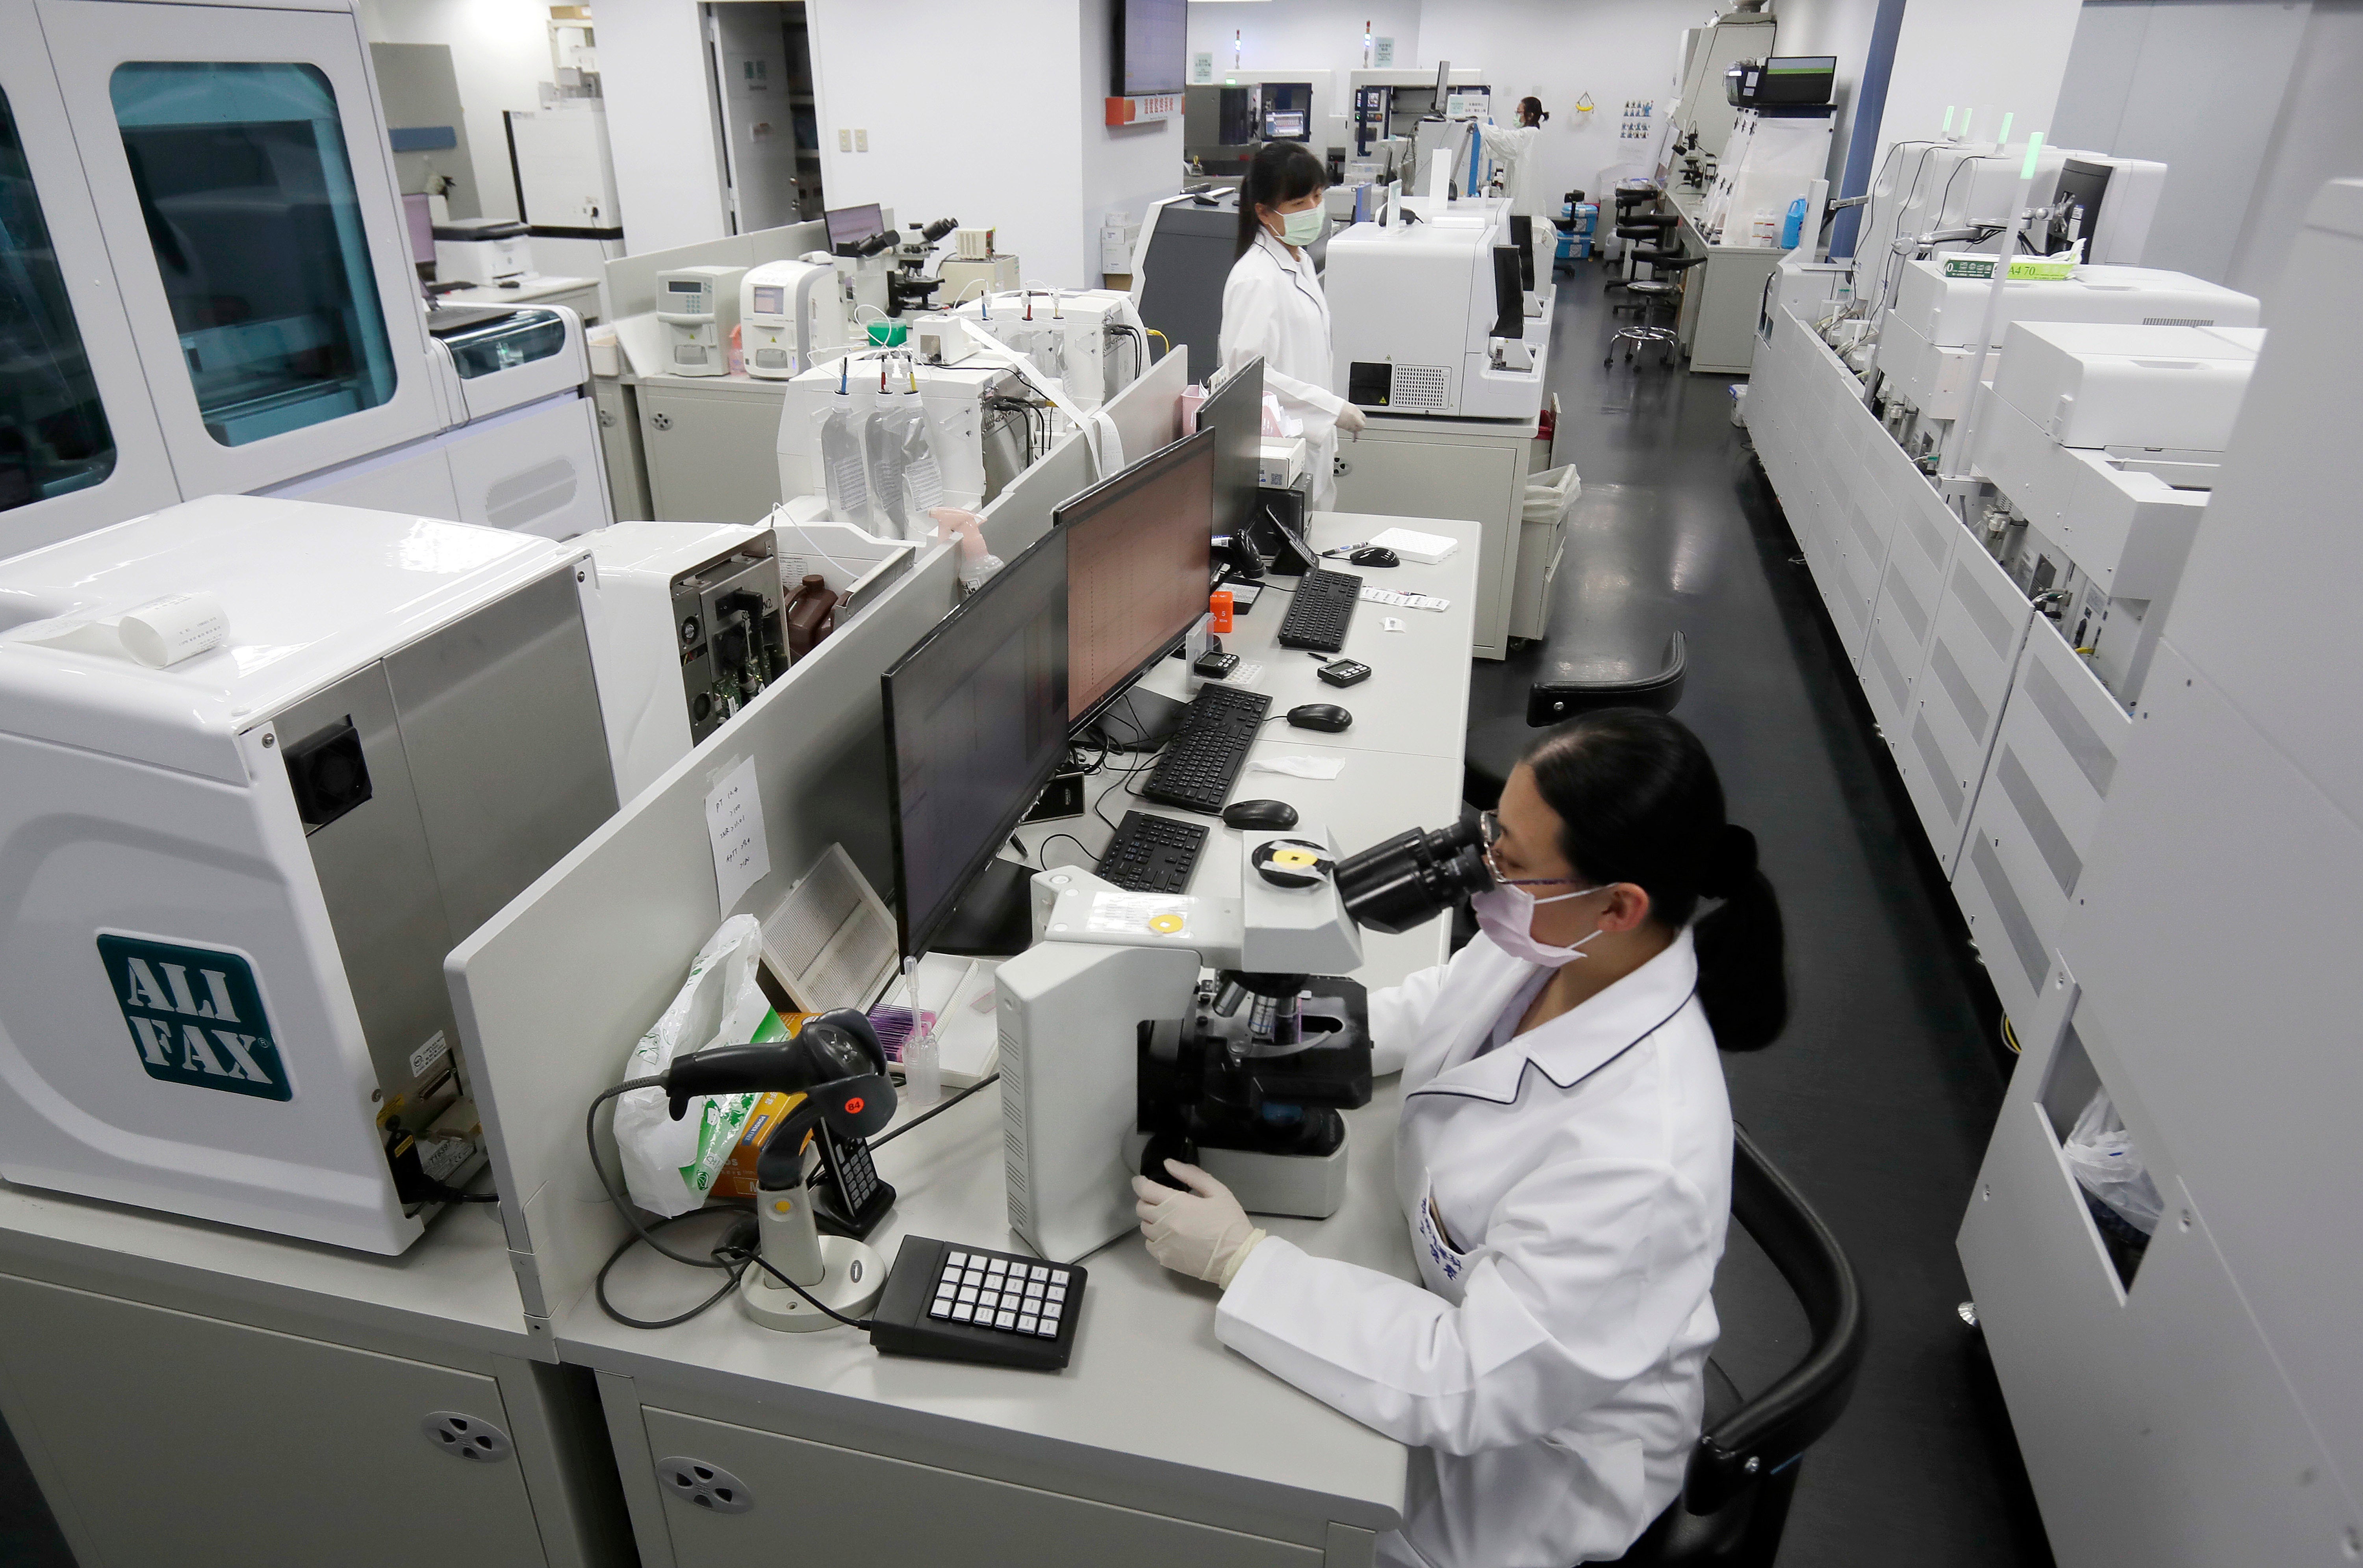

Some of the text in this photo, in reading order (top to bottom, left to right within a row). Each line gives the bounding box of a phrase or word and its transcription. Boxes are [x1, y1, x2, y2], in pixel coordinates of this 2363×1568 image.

[2007, 266, 2035, 276] A4 70
[128, 957, 241, 1023] ALI
[129, 1016, 273, 1084] FAX
[848, 1102, 860, 1111] 84
[751, 1116, 766, 1132] POWDER
